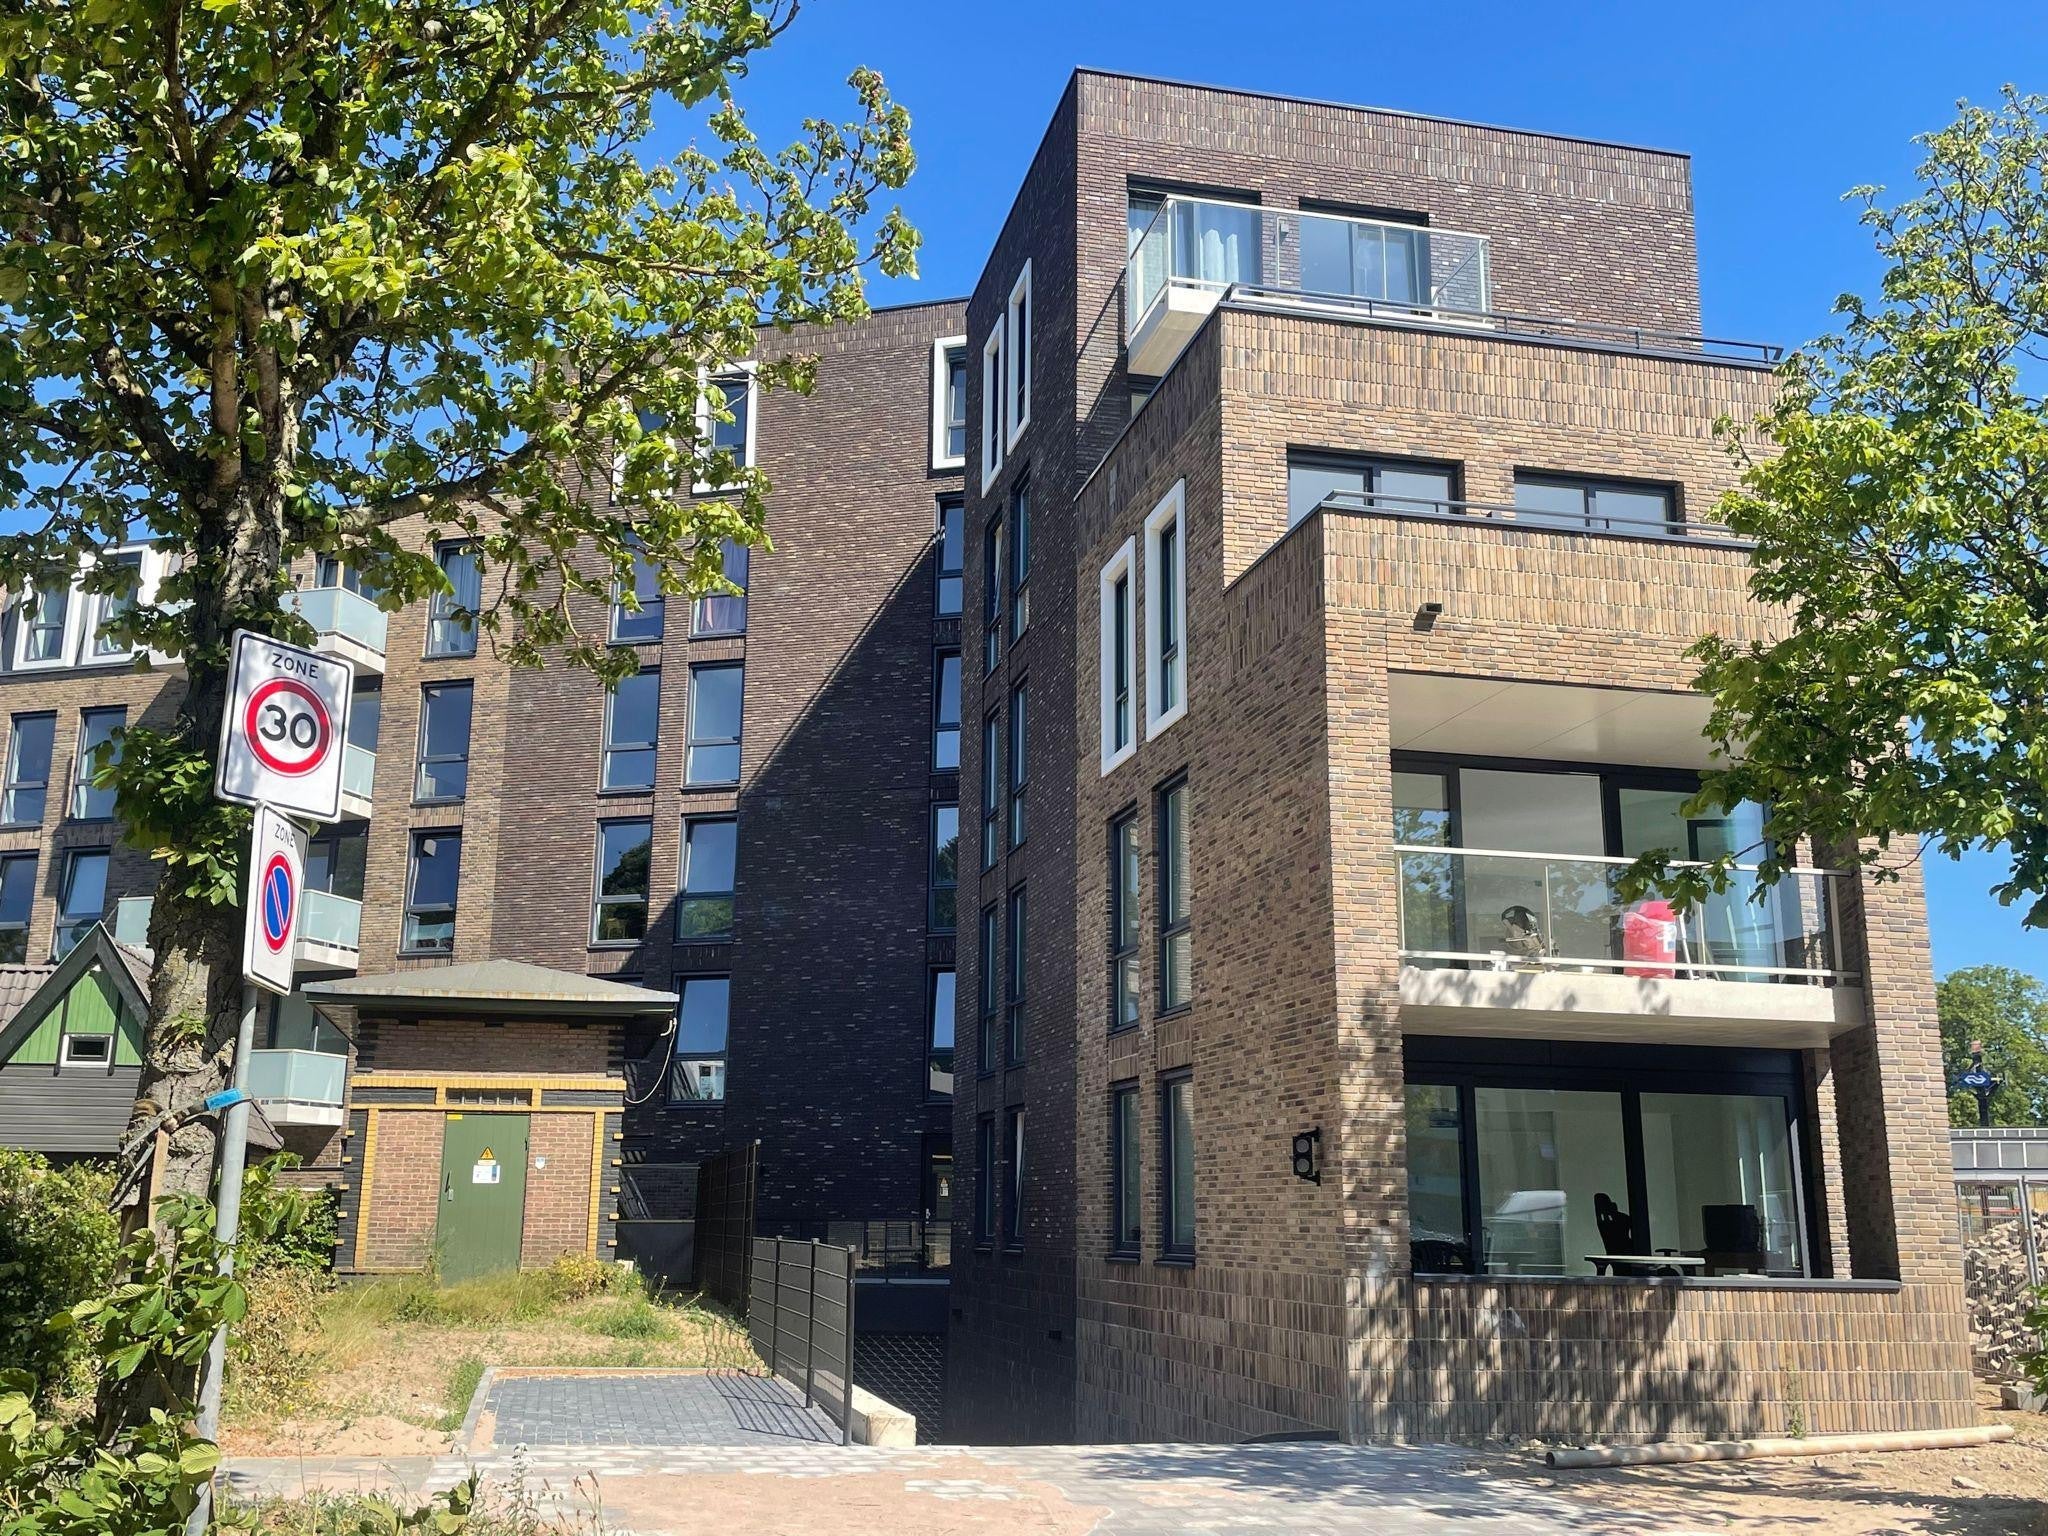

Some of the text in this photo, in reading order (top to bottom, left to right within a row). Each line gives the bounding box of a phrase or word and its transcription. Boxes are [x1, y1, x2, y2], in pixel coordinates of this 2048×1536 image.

[272, 652, 319, 679] ZONE
[260, 704, 317, 749] 30
[274, 823, 296, 848] ZONE
